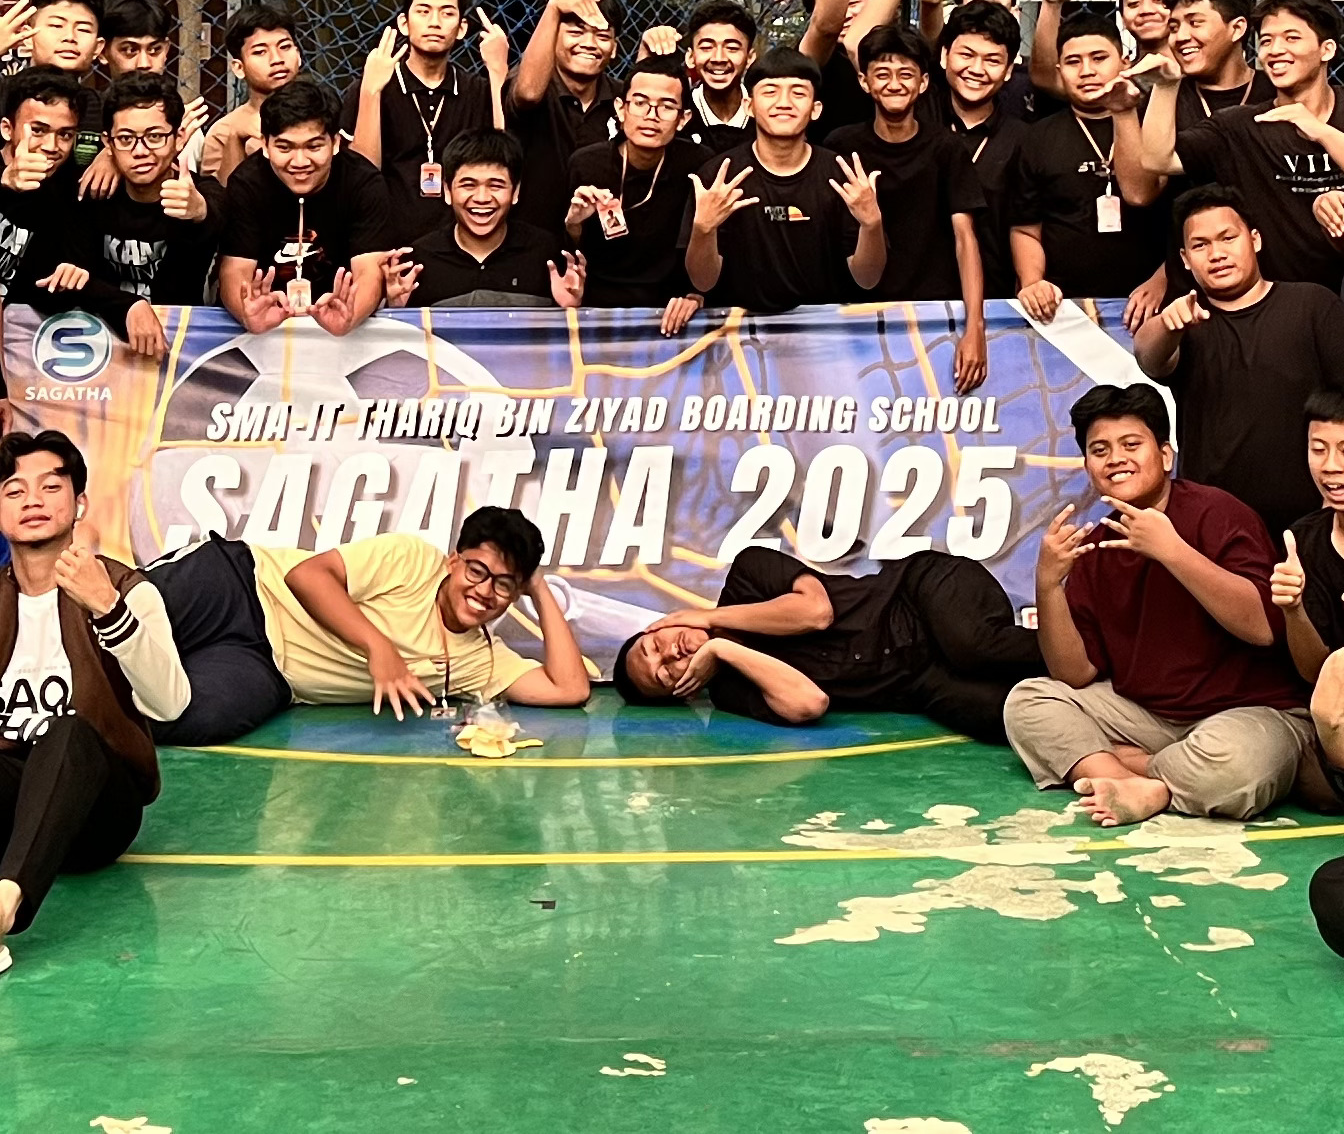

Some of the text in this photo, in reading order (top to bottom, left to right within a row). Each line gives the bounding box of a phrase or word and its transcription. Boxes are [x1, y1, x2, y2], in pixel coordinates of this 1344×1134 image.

[25, 386, 113, 401] SAGATHA
[207, 394, 1000, 442] SMA-IT THARIQ BIN ZIYAD BOARDING SCHOOL
[716, 444, 1019, 563] 2025
